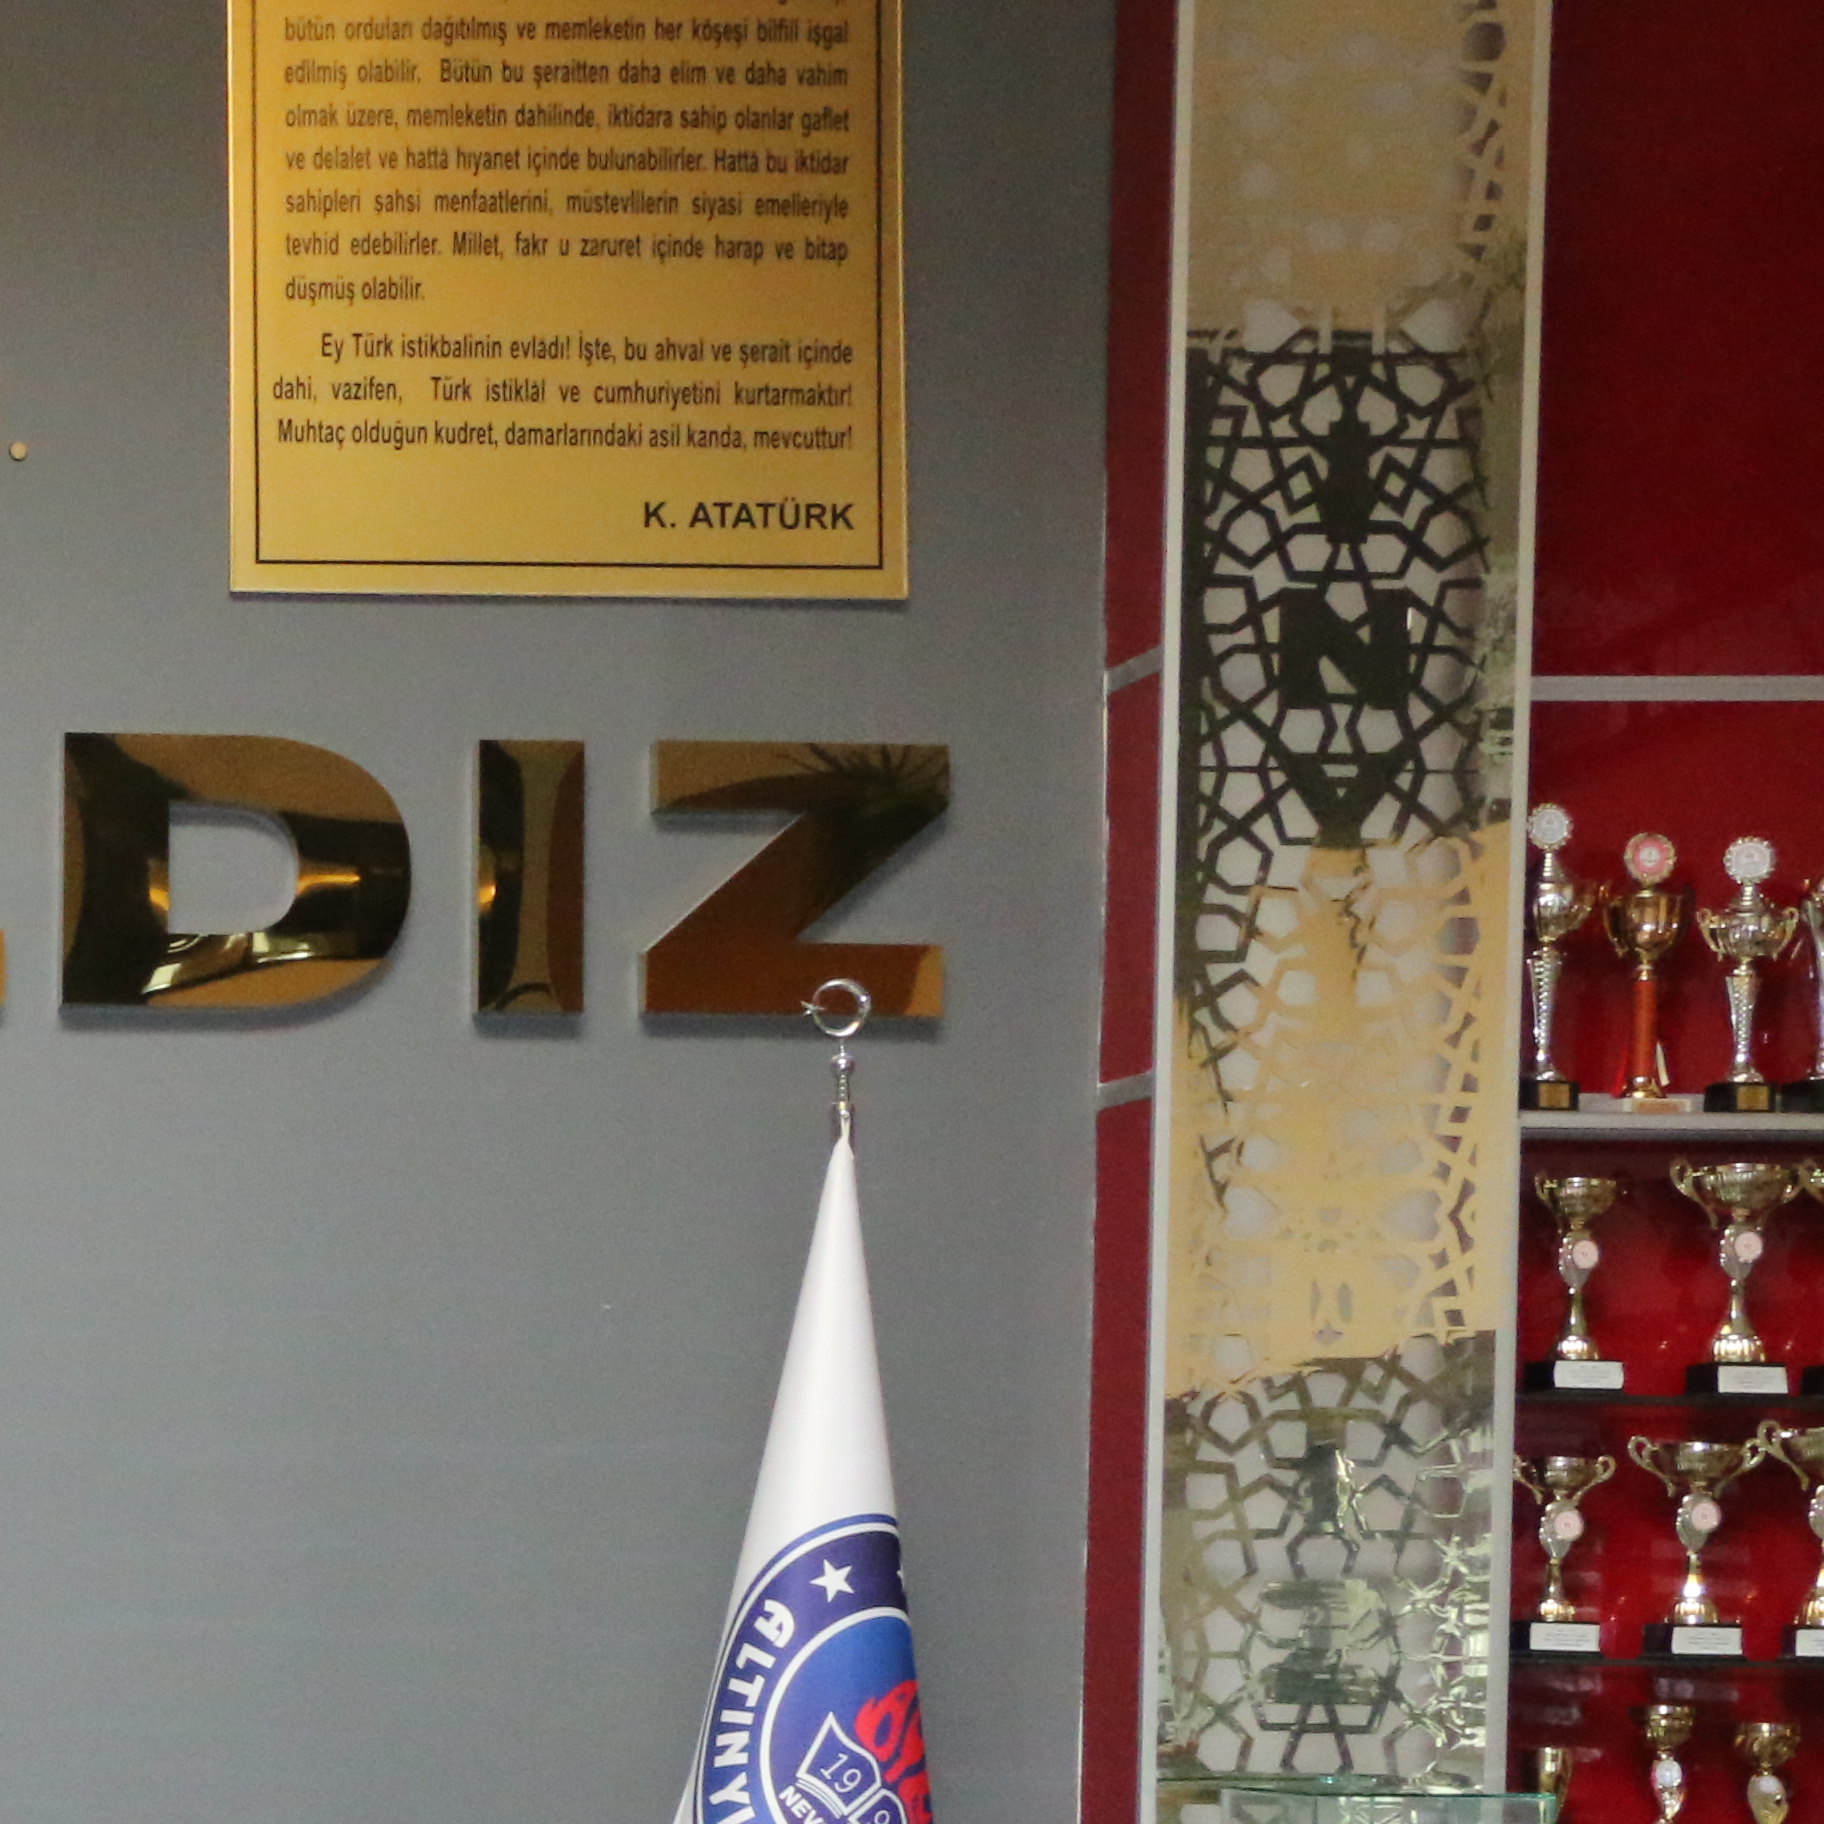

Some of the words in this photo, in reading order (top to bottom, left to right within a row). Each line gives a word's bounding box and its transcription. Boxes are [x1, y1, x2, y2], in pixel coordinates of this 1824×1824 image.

[321, 332, 345, 365] Ey
[351, 332, 394, 358] Türk
[401, 333, 502, 359] istikbalinin
[509, 335, 571, 360] evladı!
[624, 336, 648, 362] bu
[654, 337, 704, 362] ahval
[711, 343, 732, 363] ve
[739, 338, 791, 369] şerait
[798, 338, 853, 370] içinde
[272, 375, 317, 402] dahi,
[331, 375, 403, 405] vazifen,
[430, 376, 472, 402] Türk
[558, 384, 581, 404] ve
[593, 379, 721, 412] cumhuriyetini
[734, 381, 852, 407] kurtarmaktır!
[277, 418, 346, 451] Muhtaç
[434, 420, 498, 449] kudret,
[504, 421, 643, 448] damarlarındaki
[648, 423, 680, 448] asil
[686, 423, 747, 451] kanda,
[753, 424, 853, 450] mevcuttur!
[643, 501, 676, 529] K.
[688, 496, 855, 531] ATATÜRK
[820, 1752, 862, 1793] 19
